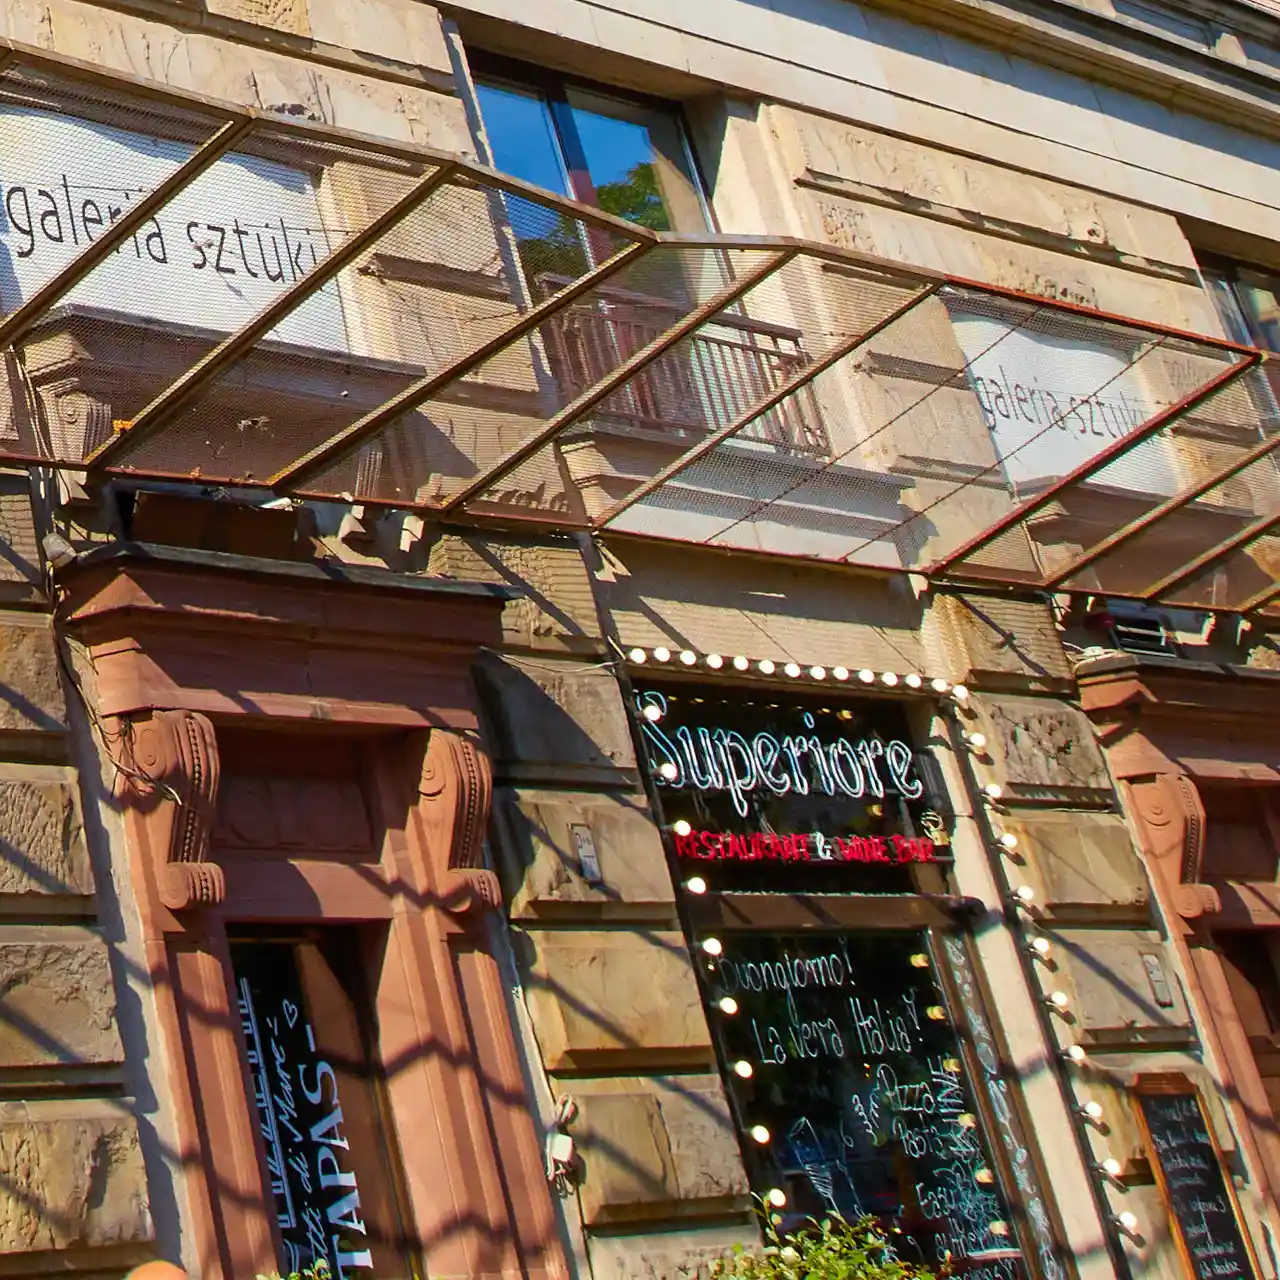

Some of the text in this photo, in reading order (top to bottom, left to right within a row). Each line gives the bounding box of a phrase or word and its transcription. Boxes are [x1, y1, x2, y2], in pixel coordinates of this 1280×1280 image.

[975, 364, 1066, 431] galeria
[636, 691, 924, 818] Superiore
[674, 830, 811, 862] RESTAURANT
[837, 833, 891, 863] WINE
[893, 833, 938, 865] BAR
[751, 1017, 787, 1065] La
[297, 1060, 375, 1280] TAPAS
